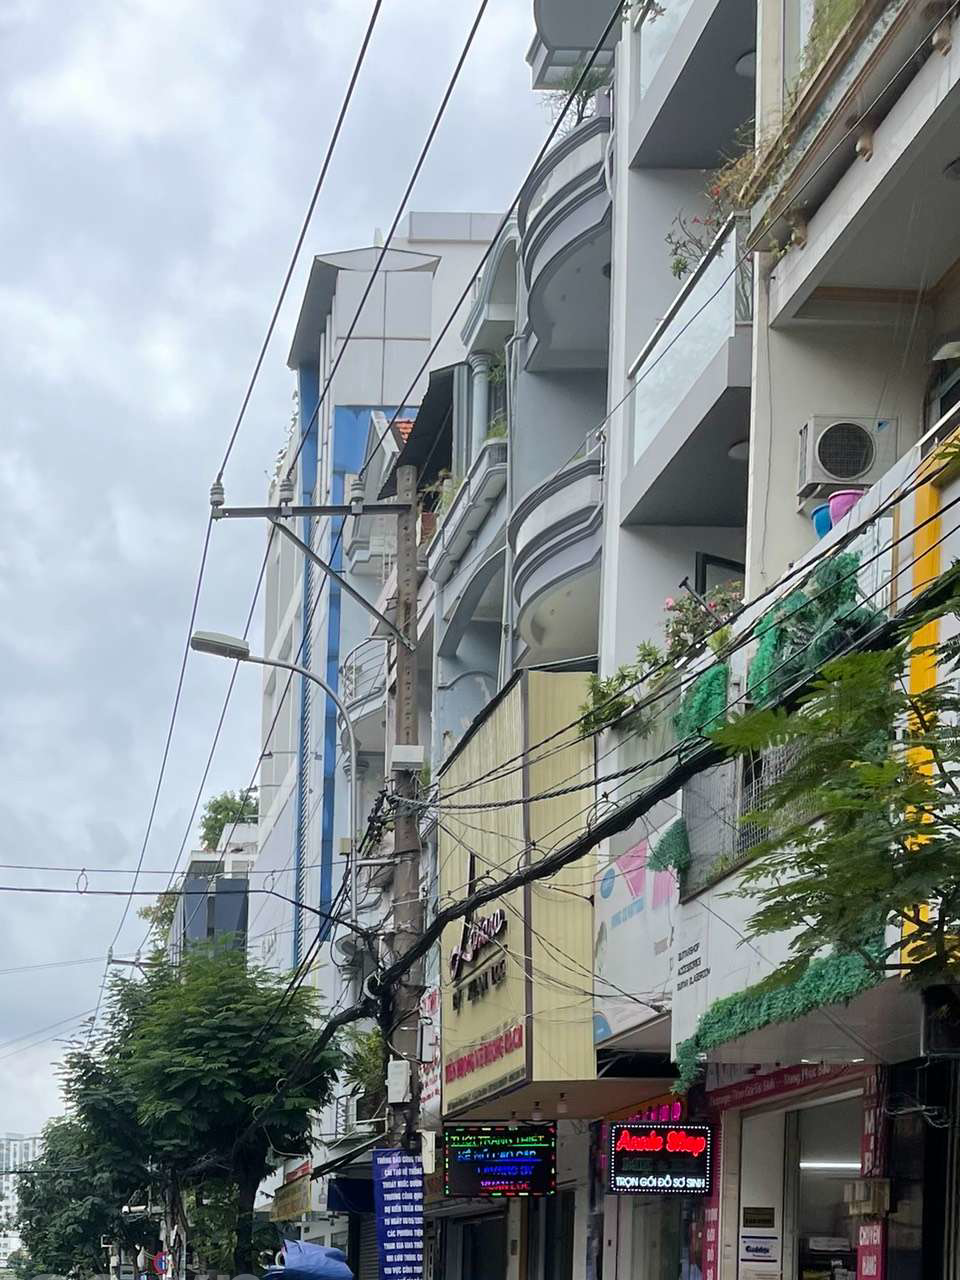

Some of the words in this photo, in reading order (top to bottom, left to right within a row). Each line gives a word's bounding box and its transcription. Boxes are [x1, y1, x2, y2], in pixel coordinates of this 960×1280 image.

[666, 1130, 706, 1157] Shop
[616, 1176, 639, 1188] TRỌN
[640, 1175, 657, 1187] GÓI
[658, 1174, 672, 1187] ĐỒ
[686, 1178, 705, 1188] SINH
